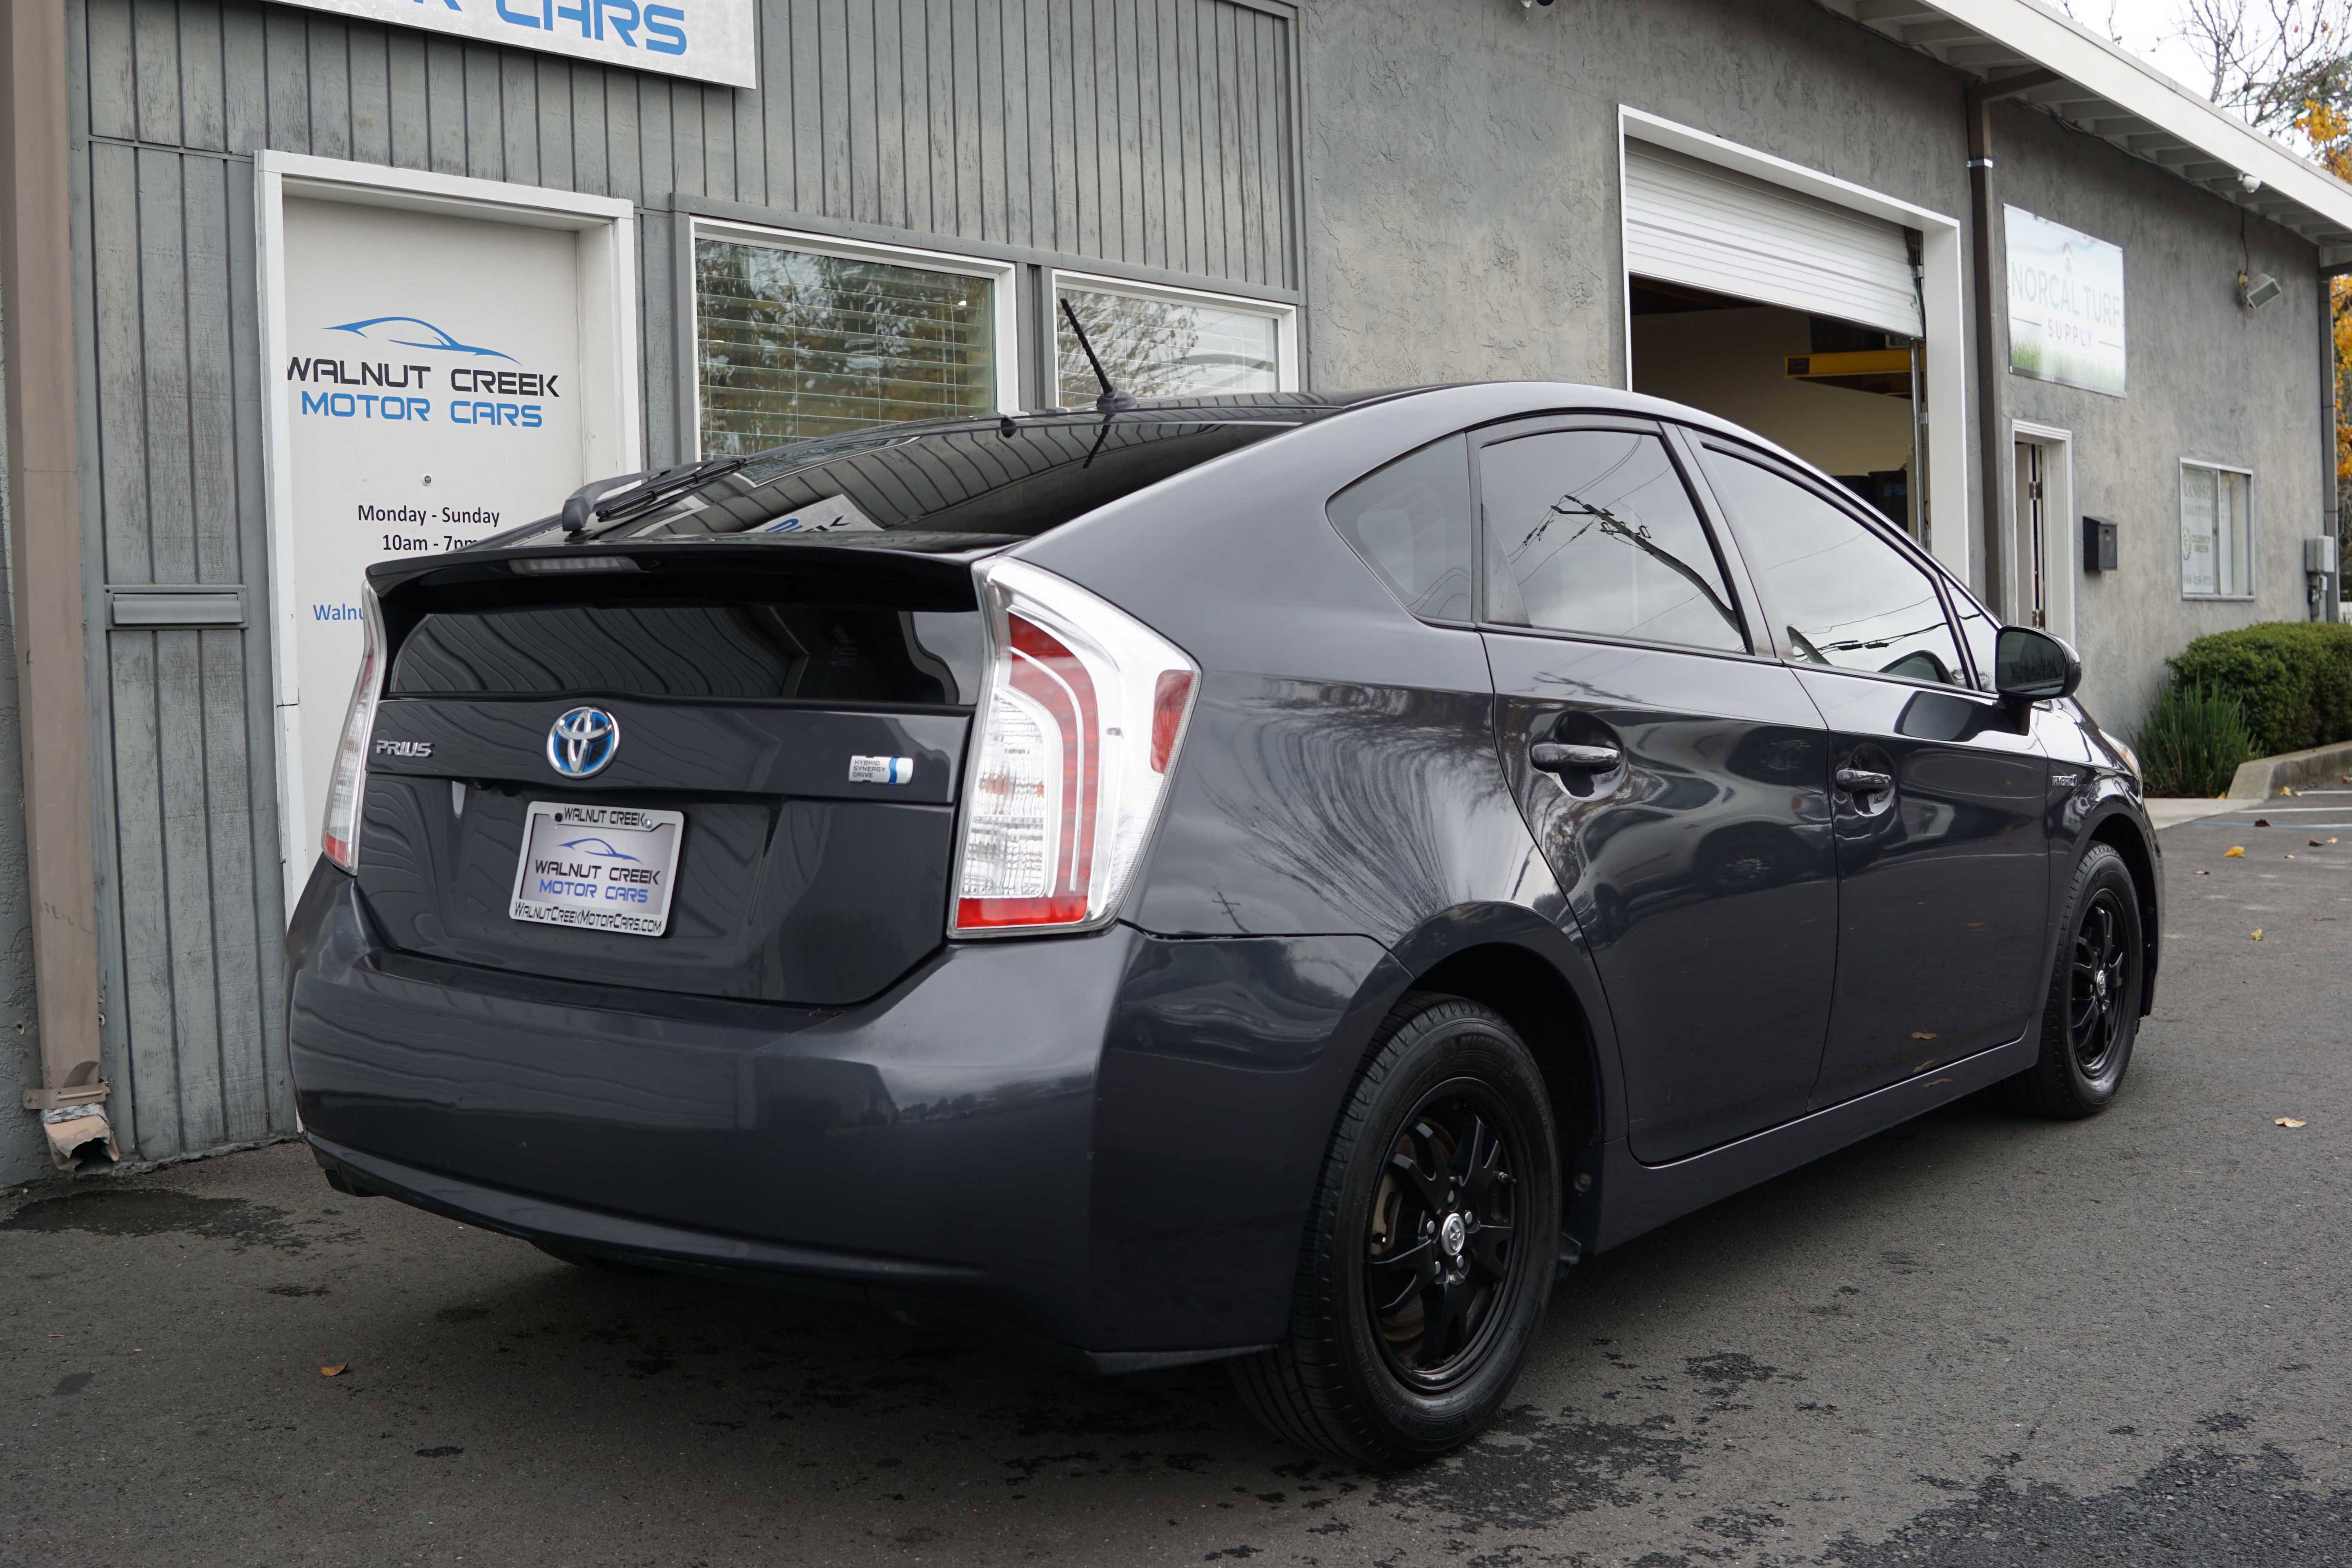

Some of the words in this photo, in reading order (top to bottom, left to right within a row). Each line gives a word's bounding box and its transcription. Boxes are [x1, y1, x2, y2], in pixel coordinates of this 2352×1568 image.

[496, 0, 687, 56] CARS
[2011, 262, 2080, 315] NORCAL
[2083, 285, 2121, 327] TURF
[2048, 318, 2092, 347] SUPPLY
[287, 356, 431, 388] WALNUT
[451, 368, 560, 398] CREEK
[301, 391, 430, 422] MOTOR
[450, 401, 542, 428] CARS
[358, 505, 427, 526] Monday
[442, 507, 500, 527] Sunday
[383, 535, 428, 550] 10am
[376, 739, 432, 757] PRIUS
[564, 807, 606, 823] WALNUT
[610, 811, 645, 826] CREEK
[535, 860, 601, 879] WALNUT
[609, 868, 661, 884] CREEK
[539, 879, 597, 898] MOTOR
[605, 886, 648, 903] CARS
